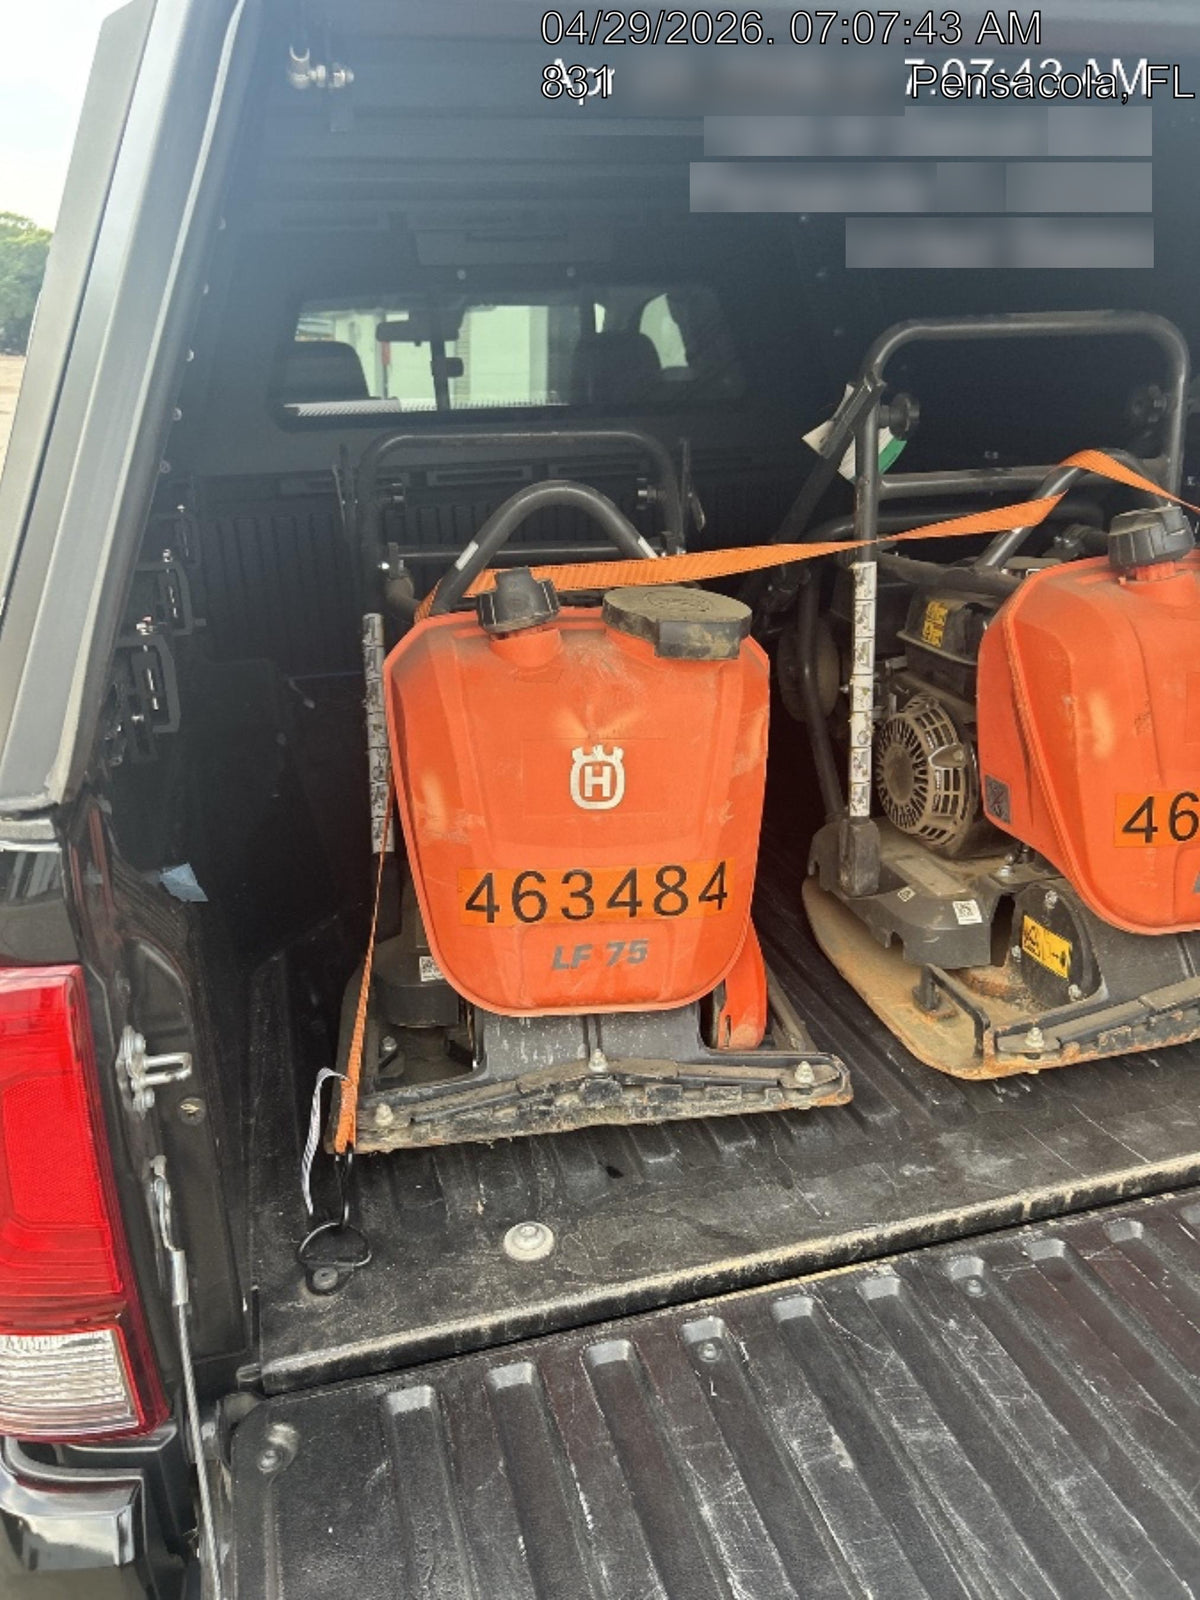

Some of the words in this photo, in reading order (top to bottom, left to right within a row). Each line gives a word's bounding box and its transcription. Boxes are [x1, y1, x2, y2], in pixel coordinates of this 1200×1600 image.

[465, 861, 728, 924] 463484
[551, 943, 594, 971] LF
[606, 939, 649, 967] 75
